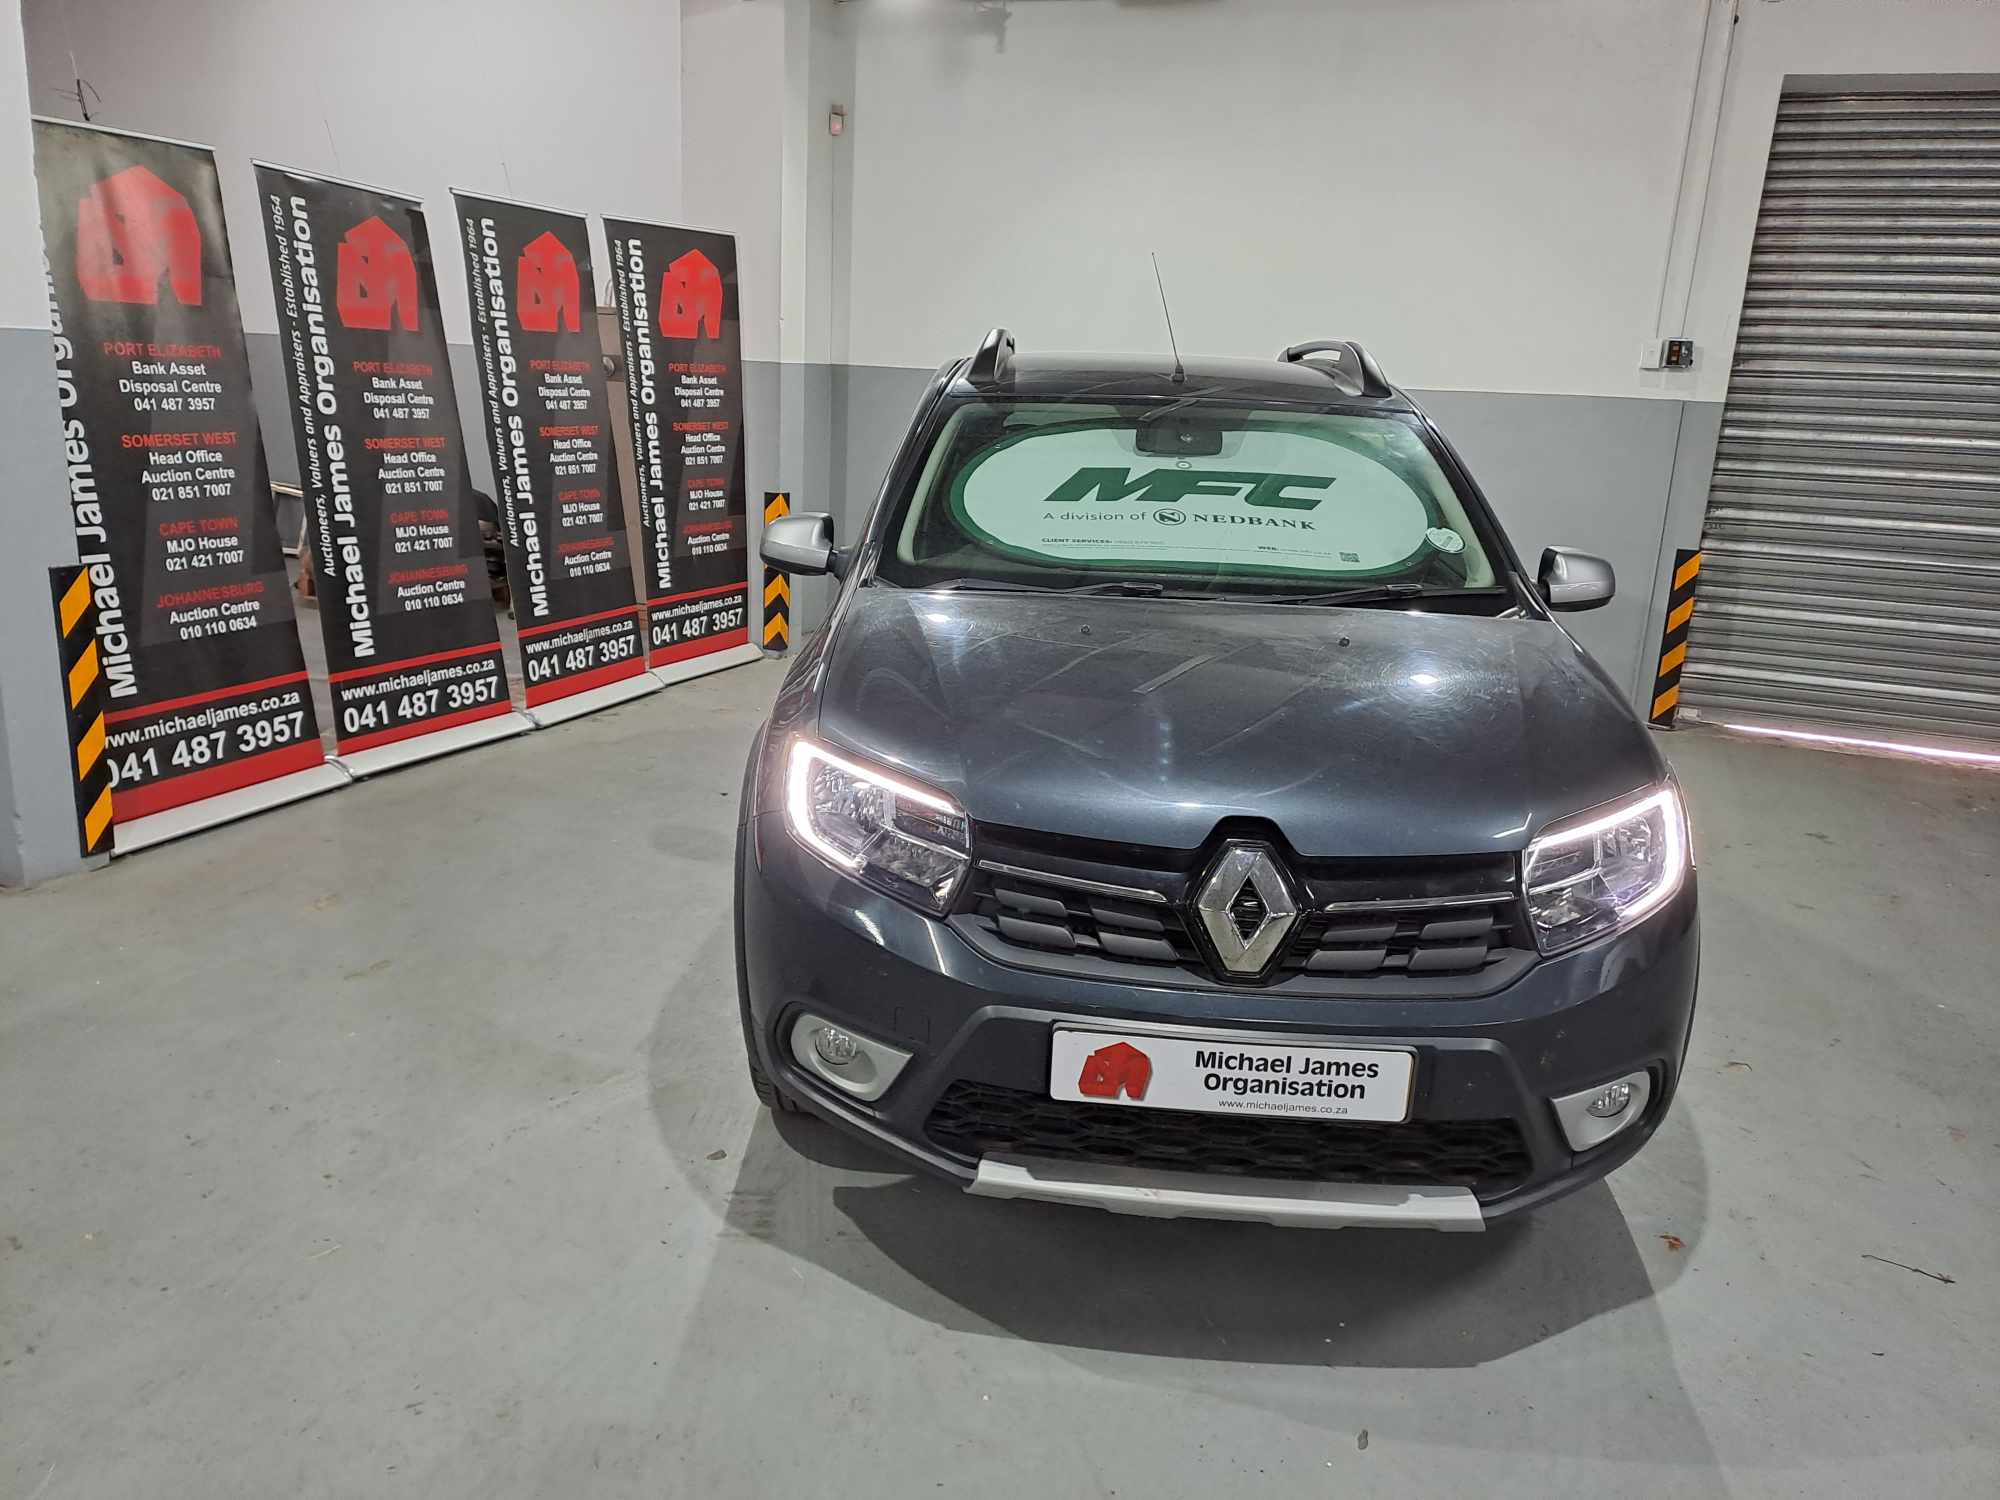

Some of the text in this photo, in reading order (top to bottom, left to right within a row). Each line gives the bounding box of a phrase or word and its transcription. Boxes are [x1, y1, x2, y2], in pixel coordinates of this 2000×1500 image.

[103, 342, 143, 357] PORT
[132, 361, 206, 375] Bank Asset
[270, 195, 337, 577] Auctioneers, Valuers and Appraisers Established 1964
[371, 377, 424, 390] Bank Asset
[544, 373, 562, 384] Bank
[119, 379, 222, 396] Disposal Centre
[133, 397, 215, 411] 041 487 3957
[363, 391, 434, 405] Disposal Centre
[373, 407, 390, 419] 041
[392, 408, 409, 419] 487
[480, 218, 549, 617] Michael James Organisation
[628, 238, 672, 590] Michael James Organisation
[290, 196, 375, 658] Michael James Organisation
[121, 431, 237, 448] SOMERSET WEST
[553, 439, 592, 449] Head Office
[149, 450, 223, 465] Head Office
[383, 452, 437, 464] Head Office
[550, 452, 575, 463] Auction
[141, 467, 236, 484] Auction Centre
[378, 466, 445, 480] Auction Centre
[152, 483, 232, 501] 021 851 7007
[385, 480, 443, 494] 021 851 7007
[1043, 467, 1337, 511] MFC
[1043, 511, 1316, 530] A division of NEDBANK
[395, 525, 449, 538] MJO House
[166, 536, 238, 553] MJO House
[395, 537, 453, 553] 021 421 7007
[64, 419, 137, 698] Michael James
[166, 550, 244, 571] 021 421 7007
[564, 553, 590, 565] Auction
[397, 580, 465, 598] Auction Centre
[170, 600, 260, 624] Auction Centre
[404, 598, 421, 611] 010
[424, 596, 439, 608] 110
[651, 595, 742, 621] www.michaeljames.co.za
[180, 615, 257, 640] 010 110 0634
[652, 607, 743, 645] 041 487 3957
[526, 620, 633, 654] www.michaeljames.co.za
[528, 634, 635, 682] 041 487 3957
[341, 659, 495, 701] www.michaeljames.co.za
[343, 676, 498, 733] 041 487 3957
[171, 731, 226, 767] 487
[237, 711, 304, 752] 3957
[1195, 1050, 1379, 1078] Michael James
[1203, 1072, 1365, 1099] Organisation
[1218, 1100, 1348, 1115] www.michaeljames.co.za
